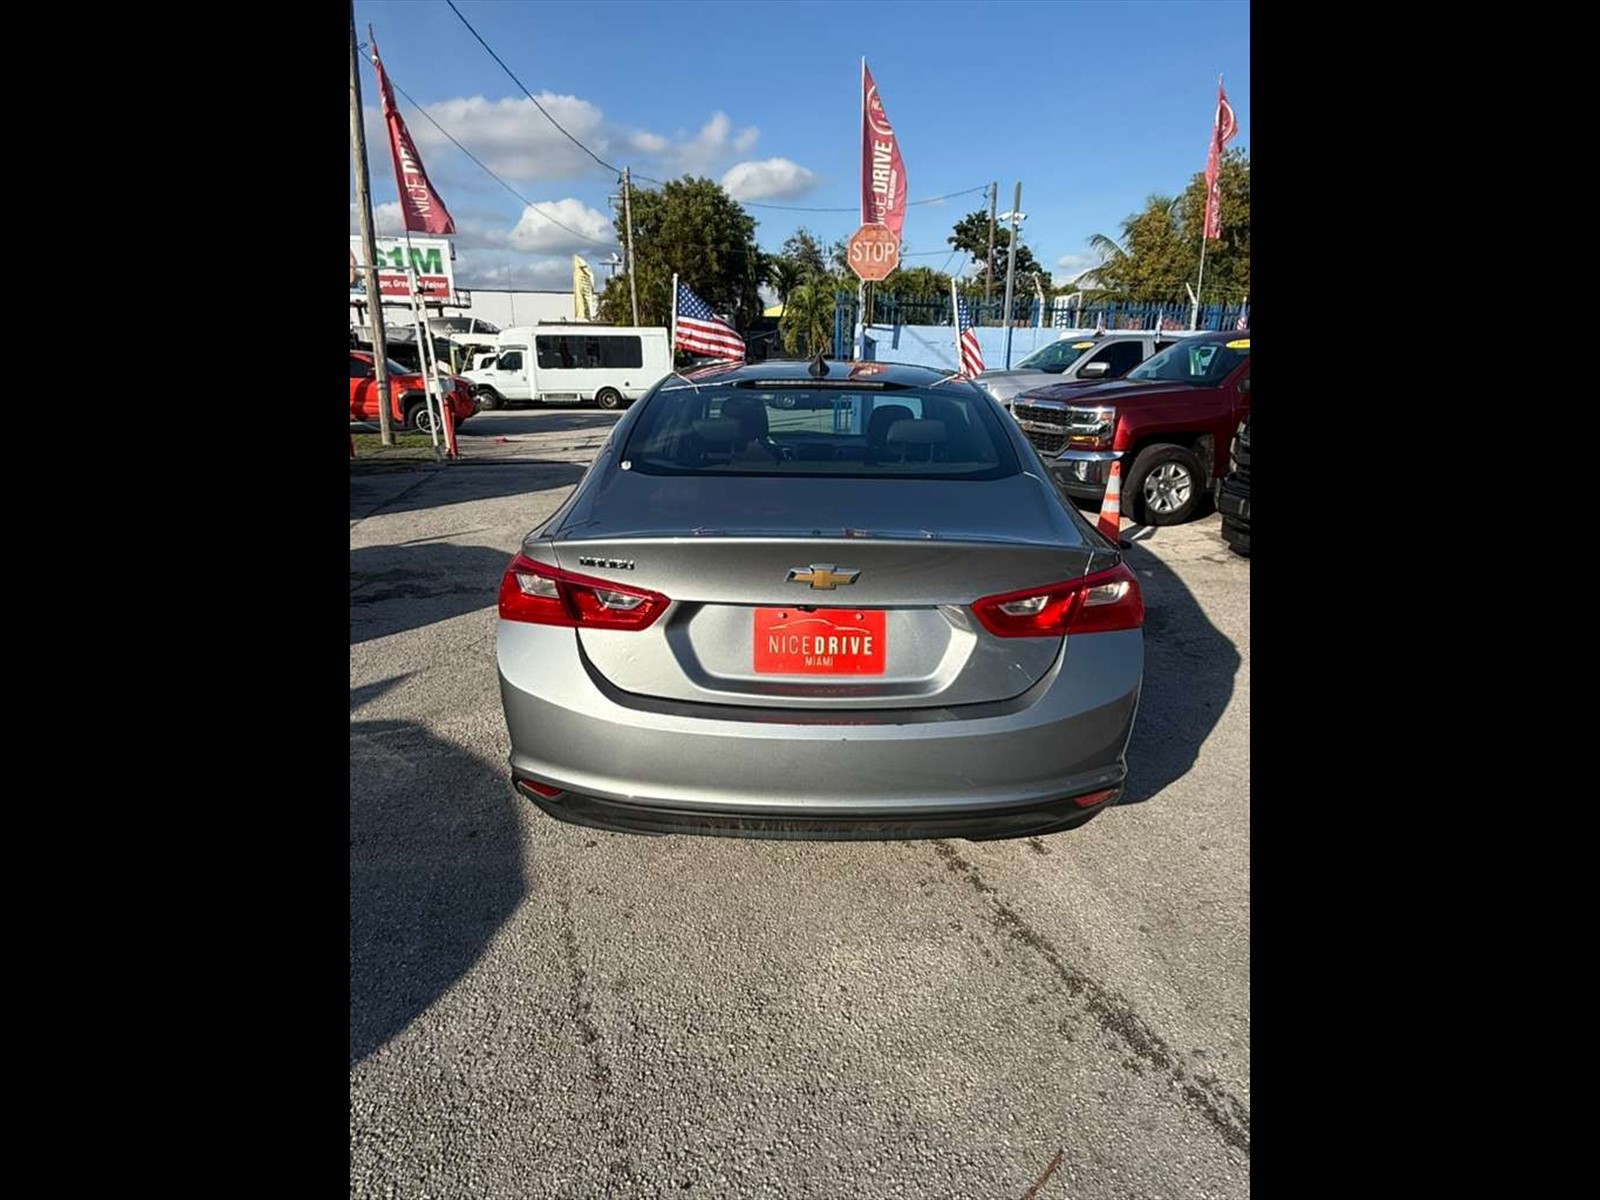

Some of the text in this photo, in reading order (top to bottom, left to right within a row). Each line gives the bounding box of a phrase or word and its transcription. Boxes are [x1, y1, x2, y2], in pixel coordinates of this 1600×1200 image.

[872, 140, 893, 195] DRIVE
[404, 174, 433, 218] NICE
[851, 240, 896, 263] STOP
[804, 656, 834, 667] MIAMI
